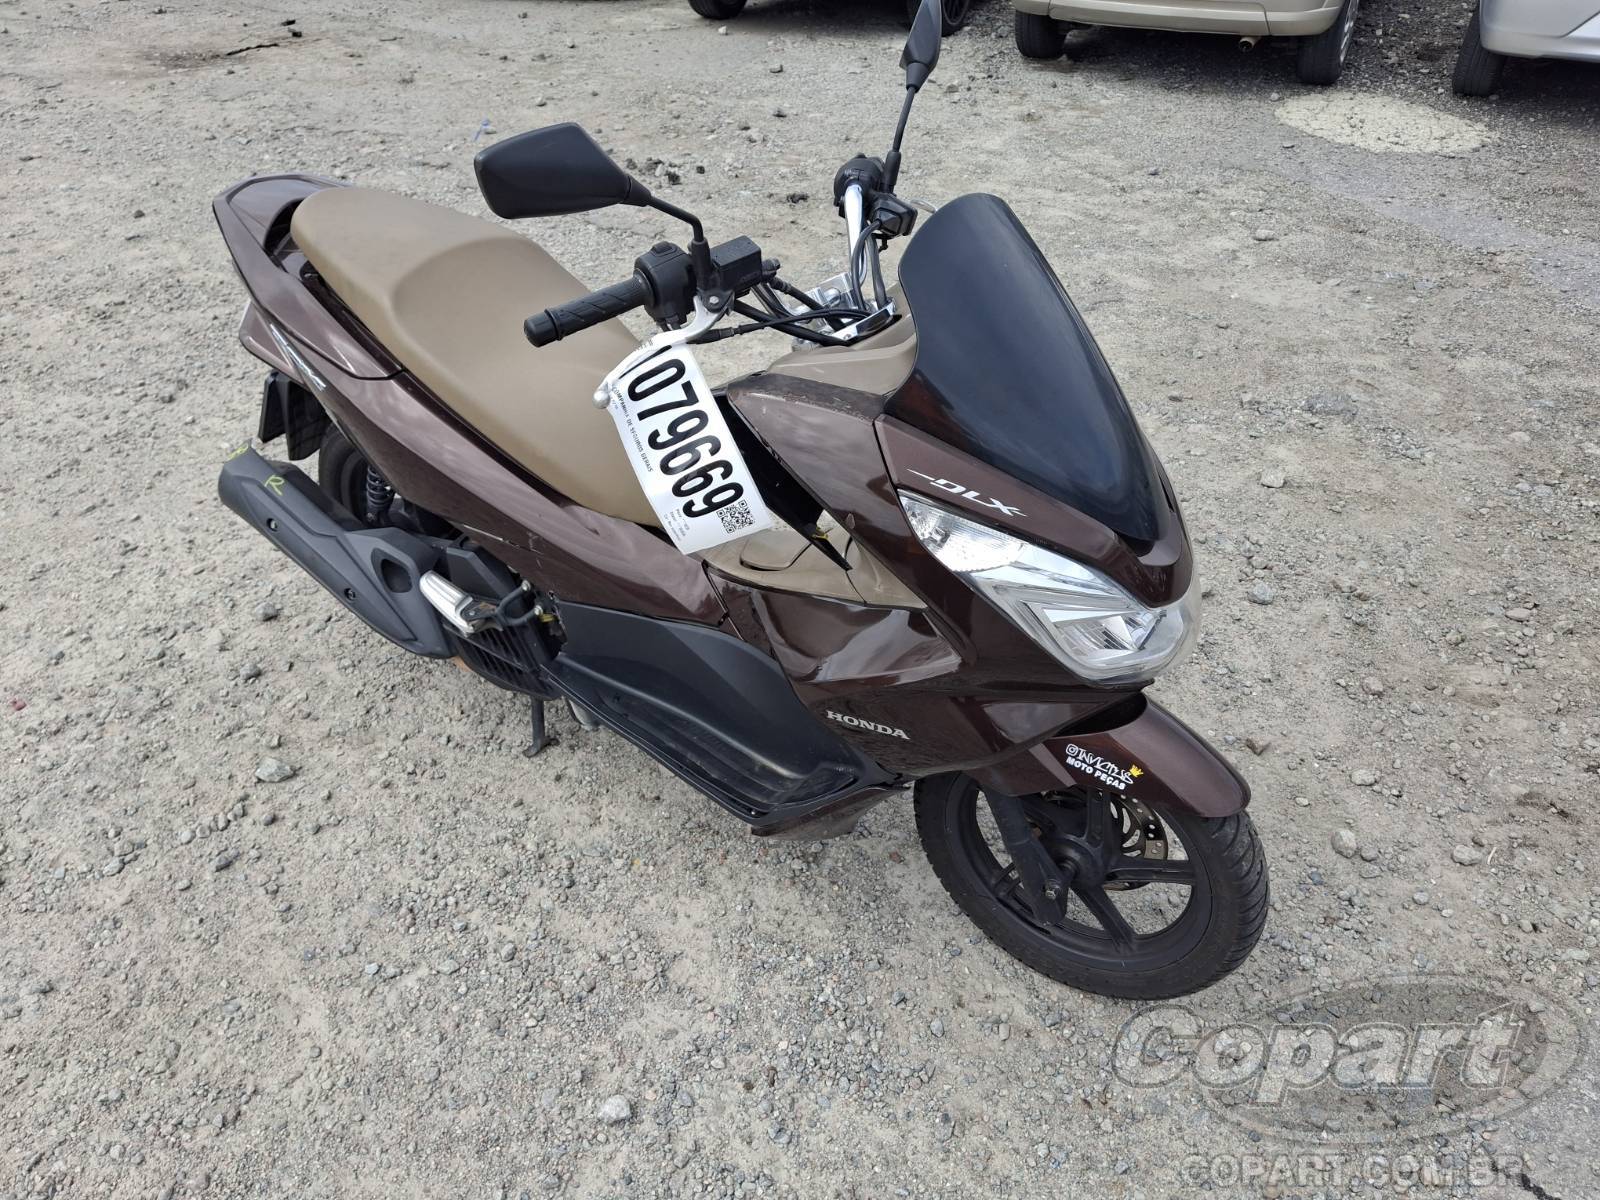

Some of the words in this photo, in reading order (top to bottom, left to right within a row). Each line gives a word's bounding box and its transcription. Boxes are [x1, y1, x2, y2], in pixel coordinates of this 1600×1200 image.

[930, 478, 1027, 517] DLX
[825, 709, 911, 740] HONDA
[1066, 756, 1094, 775] MOTO
[1094, 770, 1126, 790] PEÇAS
